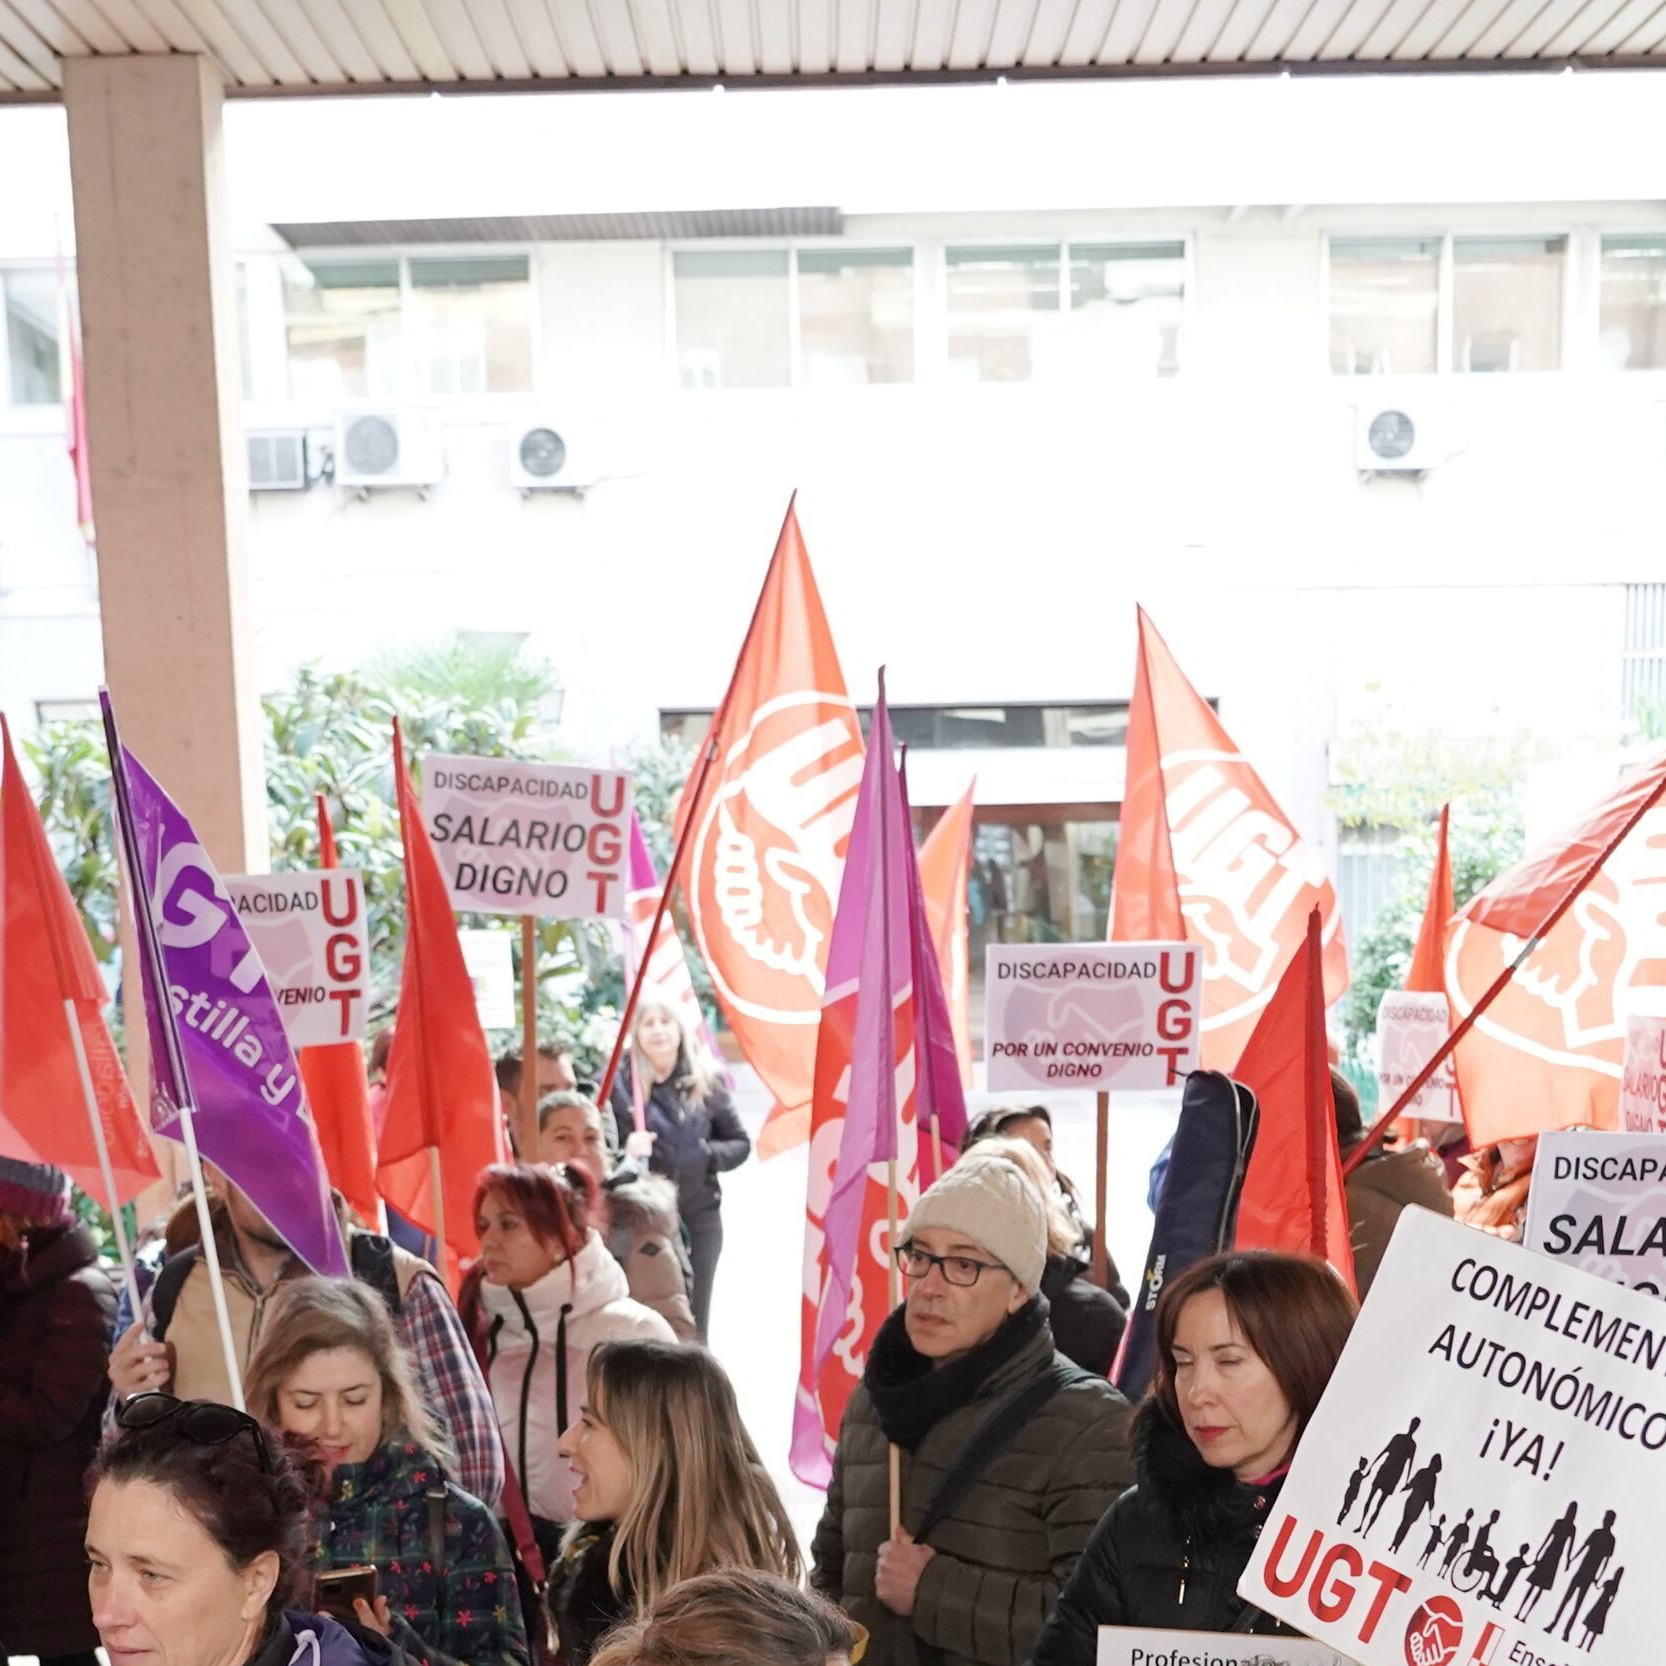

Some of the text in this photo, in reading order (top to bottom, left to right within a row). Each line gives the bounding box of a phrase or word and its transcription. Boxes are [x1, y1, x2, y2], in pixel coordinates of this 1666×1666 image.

[434, 771, 588, 800] DISCAPACIDAD
[430, 813, 586, 852] SALARIO
[586, 774, 626, 914] UGT
[455, 863, 568, 898] DIGNO
[320, 879, 361, 1036] UGT
[998, 962, 1156, 979] DISCAPACIDAD
[1156, 952, 1194, 1086] UGT
[992, 1042, 1153, 1057] POR UN CONVENIO
[1047, 1063, 1102, 1078] DIGNO
[1478, 1419, 1564, 1483] ¡YA!
[1262, 1514, 1414, 1646] UGT
